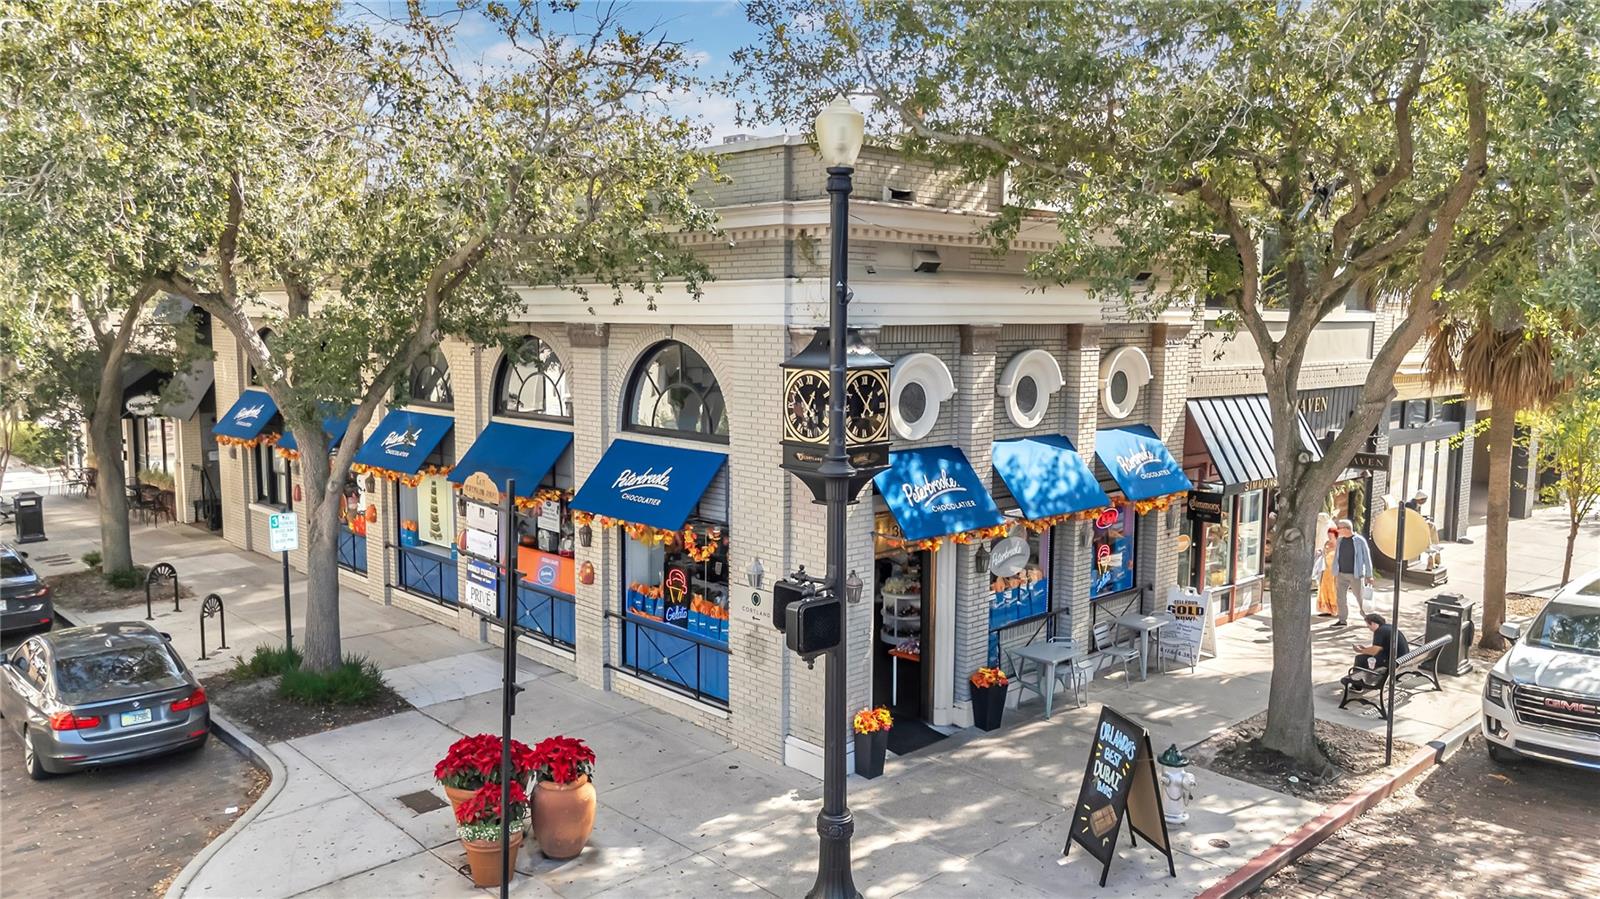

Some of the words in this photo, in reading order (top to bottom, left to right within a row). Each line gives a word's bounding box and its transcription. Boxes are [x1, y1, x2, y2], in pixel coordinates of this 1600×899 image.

[621, 493, 661, 506] CHOCOLATIER
[931, 500, 976, 513] CHOCOLATIER
[892, 525, 903, 537] 3
[666, 605, 688, 621] Gelato
[741, 605, 771, 618] CORTLAND
[1167, 605, 1204, 616] GOLD
[1544, 697, 1596, 714] GMC
[1104, 747, 1123, 768] BEST
[1093, 759, 1123, 792] DUBAI
